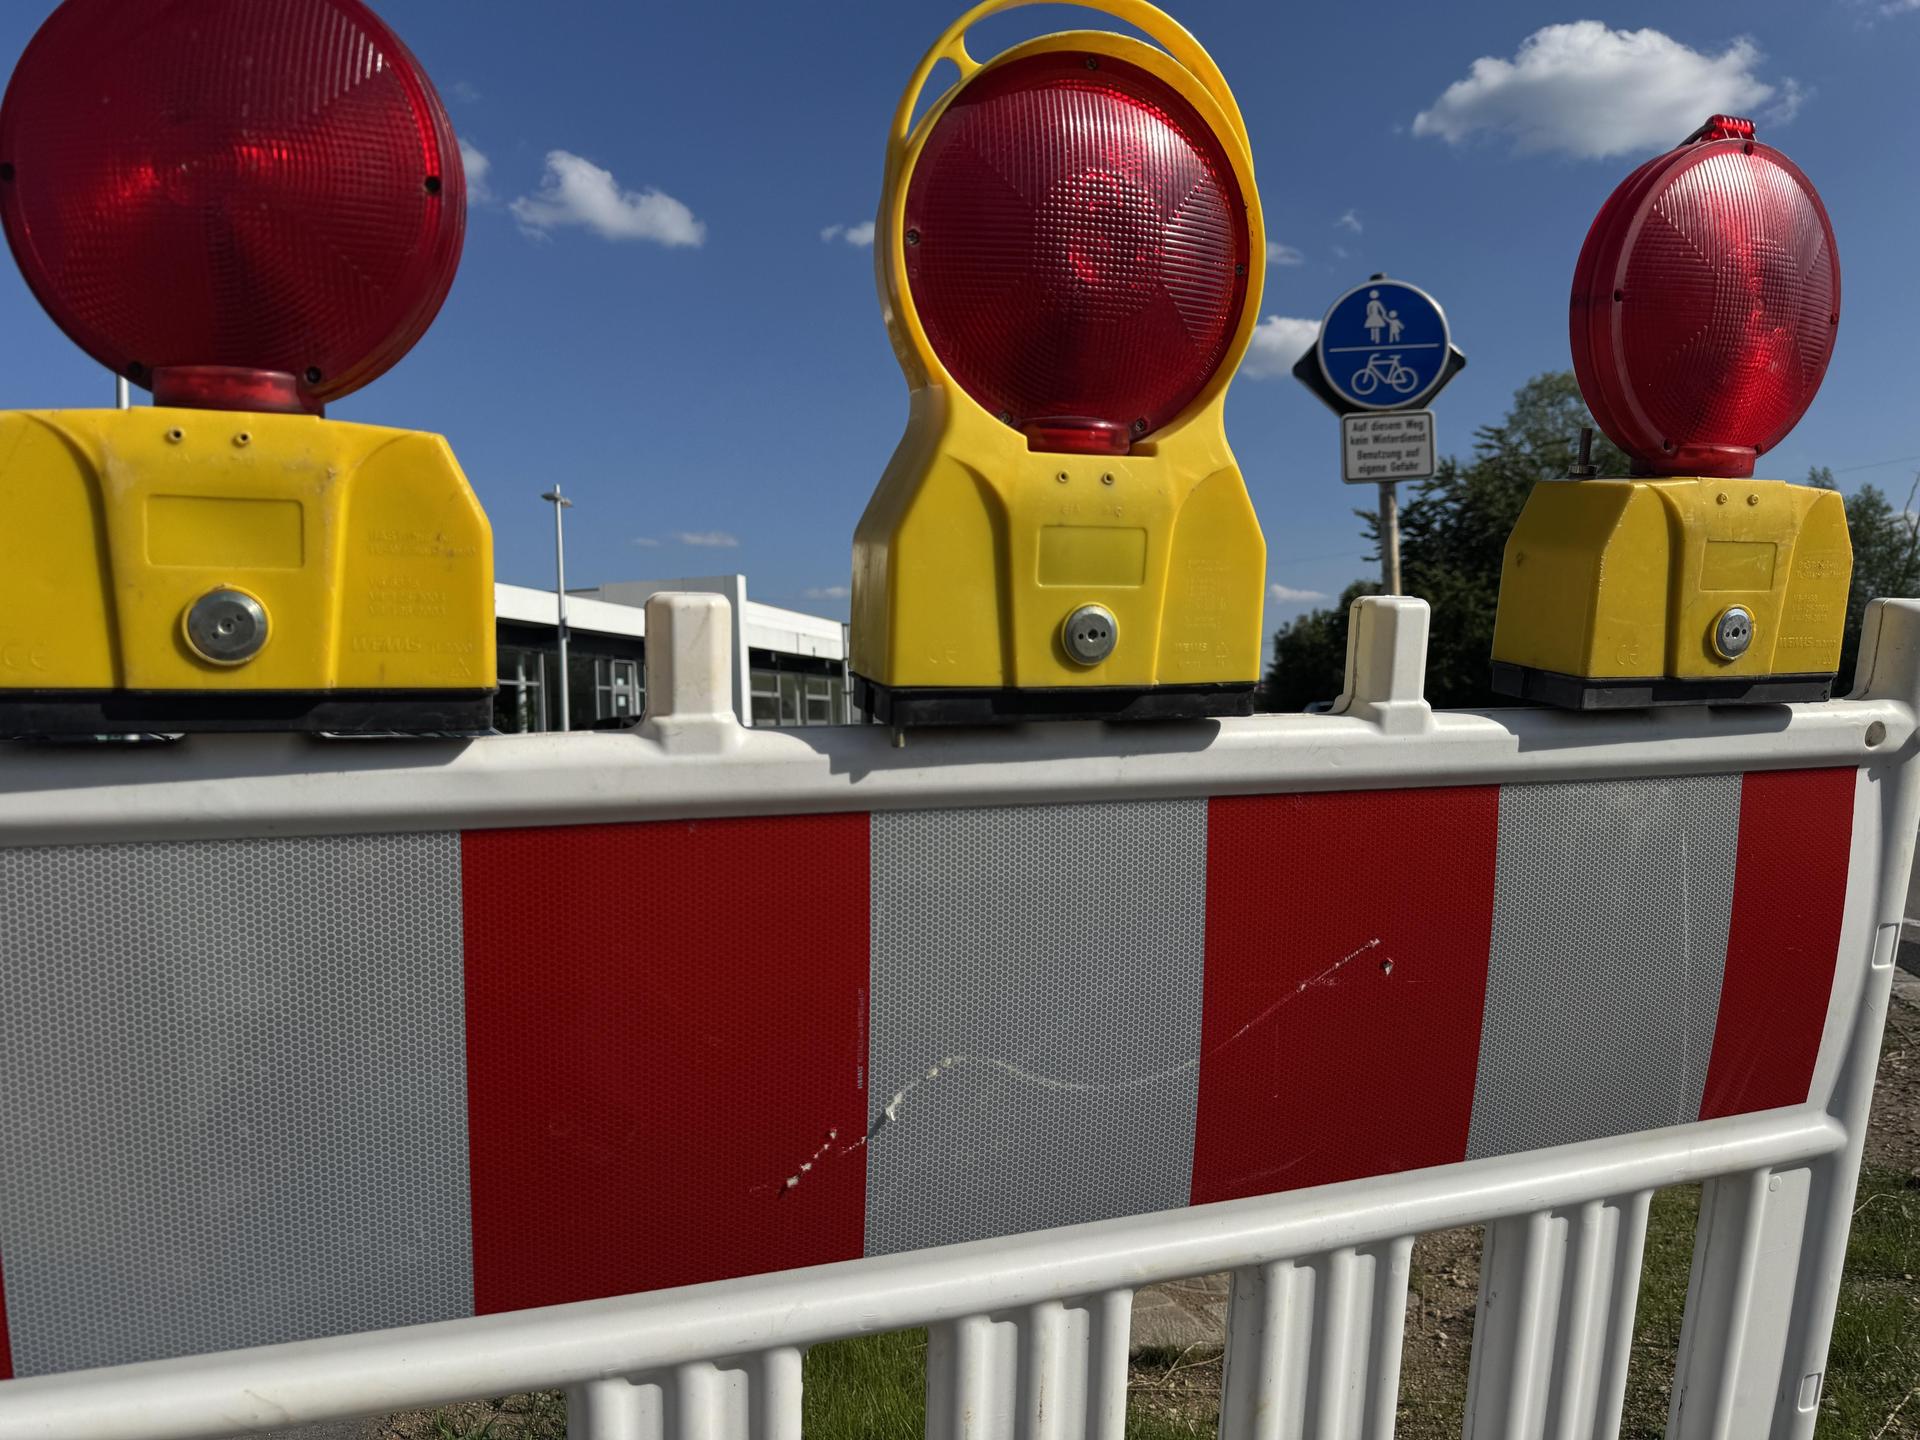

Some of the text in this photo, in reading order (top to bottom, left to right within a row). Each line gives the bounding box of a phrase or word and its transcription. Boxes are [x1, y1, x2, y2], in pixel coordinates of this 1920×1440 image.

[1353, 419, 1424, 433] Auf diesem Weg
[1350, 433, 1426, 446] kein Winterdienst
[1357, 446, 1420, 461] Benutzung auf
[1359, 461, 1420, 476] eigene Gefahr
